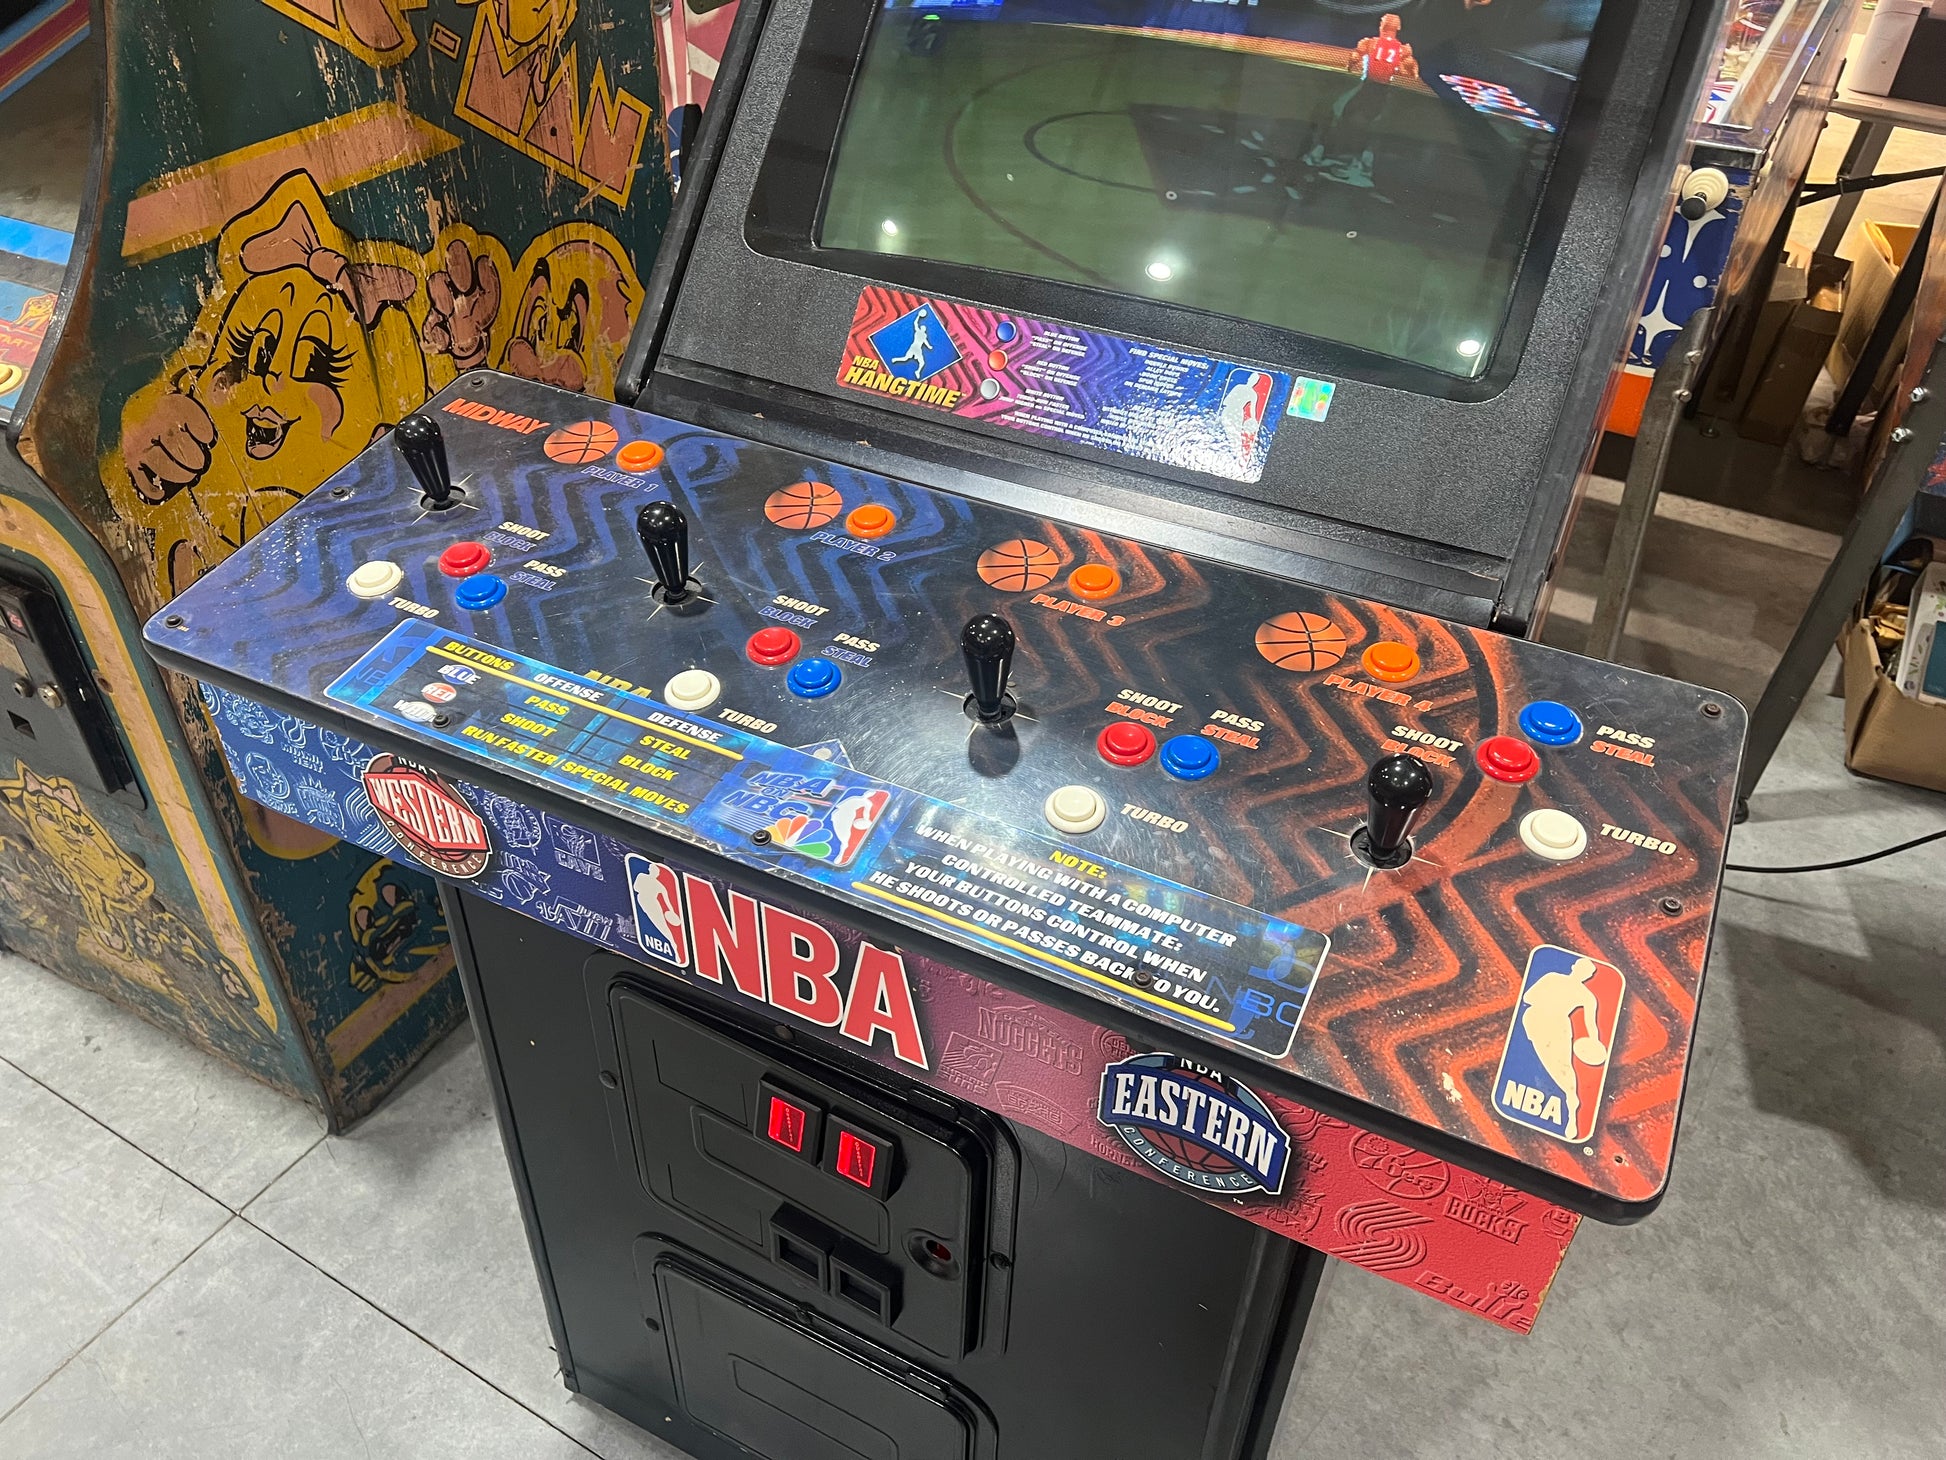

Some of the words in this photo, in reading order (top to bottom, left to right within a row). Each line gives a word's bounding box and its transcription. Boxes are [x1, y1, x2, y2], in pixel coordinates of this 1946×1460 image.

[852, 355, 879, 371] NBA
[844, 366, 961, 408] HANGTIME
[442, 398, 550, 435] MIDWAY
[581, 465, 642, 489] PLAYER
[644, 482, 660, 493] 1
[483, 530, 537, 552] BLOCK
[498, 521, 550, 541] SHOOT
[810, 531, 876, 560] PLAYER
[877, 549, 897, 562] 2
[509, 571, 557, 592] STEAL
[523, 559, 567, 579] PASS
[387, 596, 440, 619] TURBO
[758, 605, 818, 629] BLOCK
[773, 594, 830, 617] SHOOT
[1030, 593, 1107, 622] PLAYER
[1106, 615, 1126, 627] 3
[820, 644, 873, 668] STEAL
[833, 632, 881, 653] PASS
[443, 641, 516, 671] BUTTONS
[533, 672, 604, 702] OFFENSE
[648, 712, 723, 743] DEFENSE
[1117, 688, 1183, 713] SHOOT
[1323, 674, 1412, 707] PLAYER
[1413, 699, 1434, 713] 4
[437, 664, 482, 685] BLUE
[524, 695, 571, 716] PASS
[639, 735, 691, 761] STEAL
[717, 708, 779, 736] TURBO
[1104, 701, 1174, 729] BLOCK
[1210, 709, 1265, 732] PASS
[421, 684, 456, 702] RED
[500, 713, 558, 738] SHOOT
[618, 754, 679, 782] BLOCK
[1200, 724, 1262, 750] STEAL
[1391, 725, 1464, 752] SHOOT
[1596, 725, 1655, 749] PASS
[393, 700, 439, 723] WHIT
[461, 725, 500, 747] RUN
[495, 737, 555, 767] FASTER
[560, 761, 627, 793] SPECIAL
[628, 786, 691, 815] MOVES
[1590, 740, 1655, 768] STEAL
[747, 771, 836, 798] NBA
[369, 778, 480, 844] WESTERN
[722, 789, 814, 820] NBC
[1121, 803, 1189, 833] TURBO
[387, 820, 482, 874] CONFERENCE
[1600, 823, 1677, 856] TURBO
[1049, 850, 1108, 880] NOTE:
[915, 826, 972, 851] WHEN
[970, 843, 1053, 881] PLAYING
[1052, 870, 1109, 898] WITH
[1104, 892, 1121, 906] A
[1122, 898, 1237, 947] COMPUTER
[941, 854, 1067, 907] CONTROLLED
[1068, 898, 1184, 952] TEAMMATE:
[904, 862, 959, 888] YOUR
[955, 877, 1048, 922] BUTTONS
[1046, 915, 1138, 960] CONTROL
[1142, 950, 1207, 983] WHEN
[644, 934, 673, 957] NBA
[869, 871, 900, 889] HE
[896, 882, 974, 917] SHOOTS
[972, 912, 1002, 929] OR
[1000, 920, 1082, 959] PASSES
[1172, 985, 1220, 1012] YOU.
[683, 873, 931, 1071] NBA
[1502, 1079, 1562, 1125] NBA
[1112, 1073, 1277, 1177] EASTERN
[1124, 1127, 1253, 1187] CONFERENCE
[1358, 1152, 1434, 1190] 76ers
